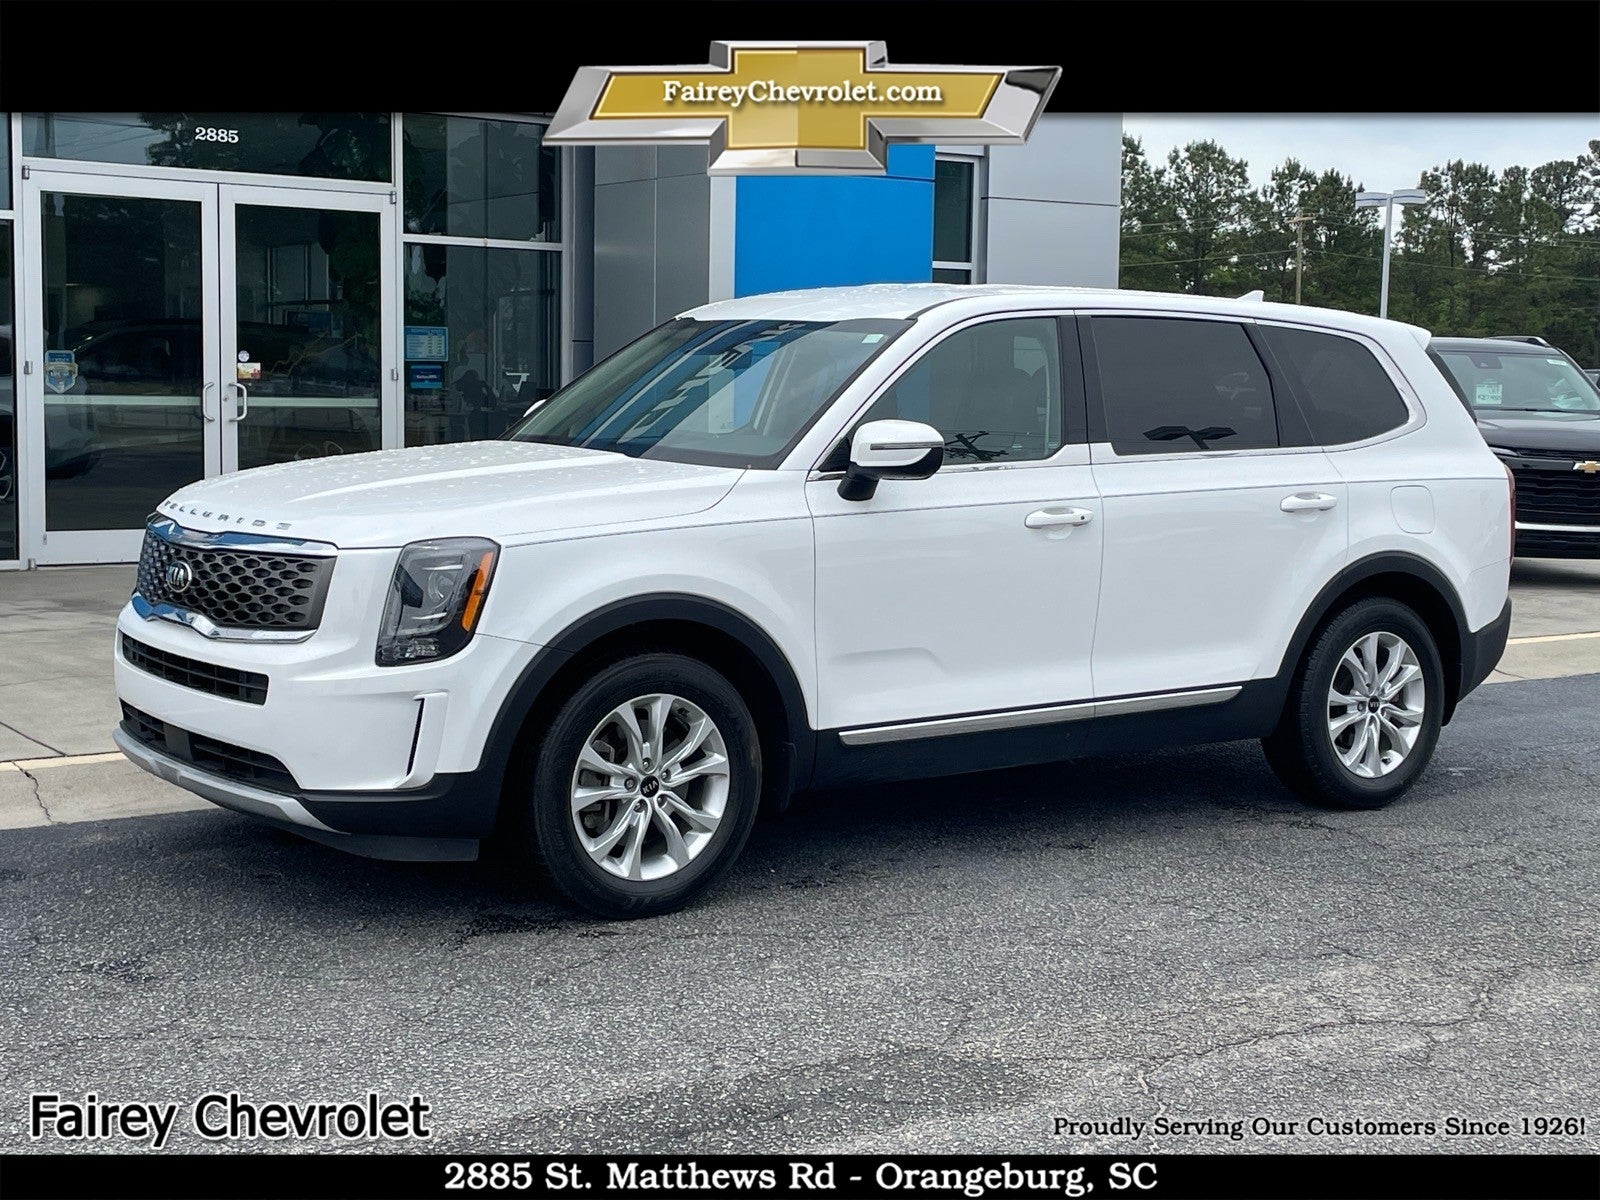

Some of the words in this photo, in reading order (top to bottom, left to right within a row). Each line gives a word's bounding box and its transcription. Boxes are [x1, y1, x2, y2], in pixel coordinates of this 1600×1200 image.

[195, 126, 239, 144] 2885
[164, 500, 293, 531] TELLURIDE
[168, 564, 187, 588] KIA
[641, 780, 659, 795] KIA
